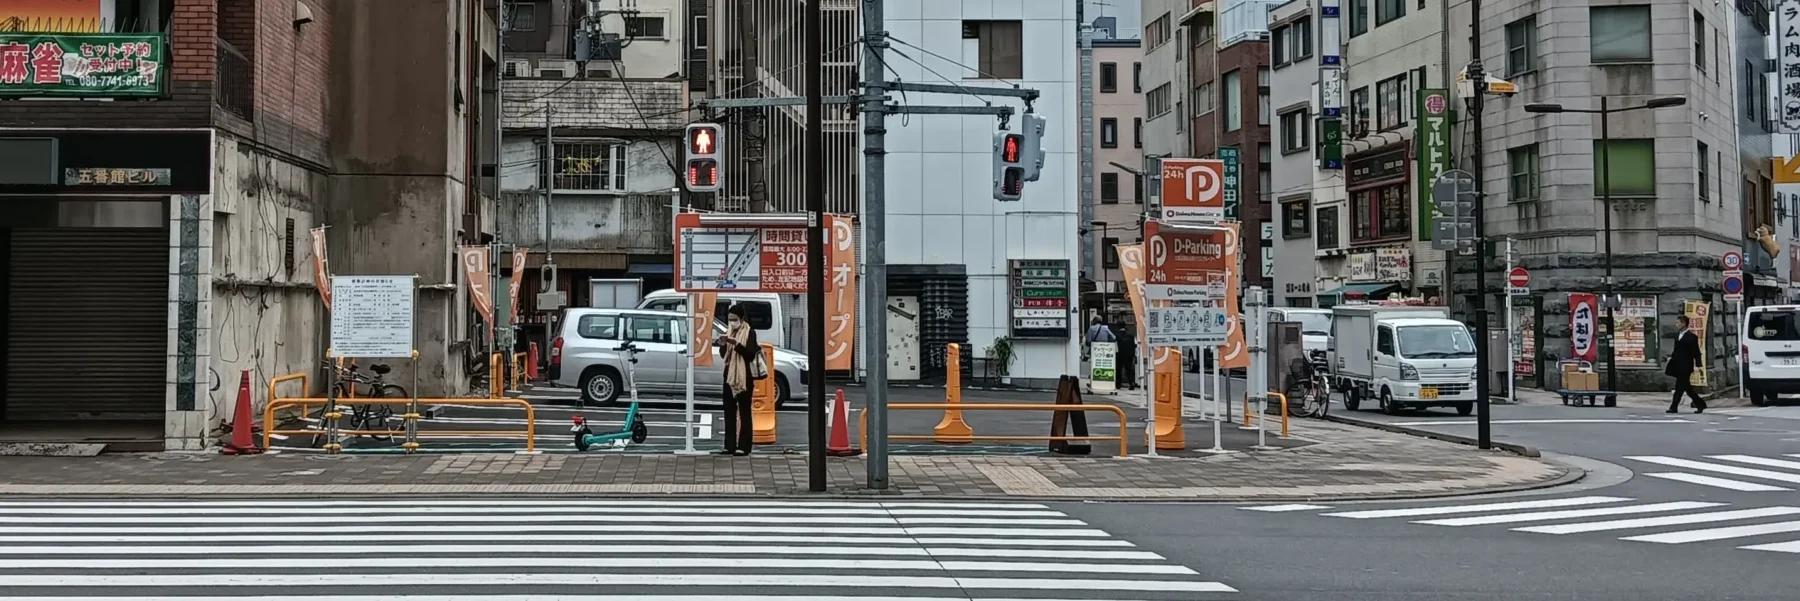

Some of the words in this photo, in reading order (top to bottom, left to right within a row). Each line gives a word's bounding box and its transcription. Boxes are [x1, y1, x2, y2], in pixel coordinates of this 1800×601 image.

[80, 43, 151, 57] セット予約
[0, 41, 63, 84] 麻雀
[78, 168, 158, 185] 五番館ビル
[1164, 170, 1184, 179] 24h
[776, 252, 807, 266] 300
[1727, 256, 1737, 264] 30
[1150, 270, 1166, 282] 24h
